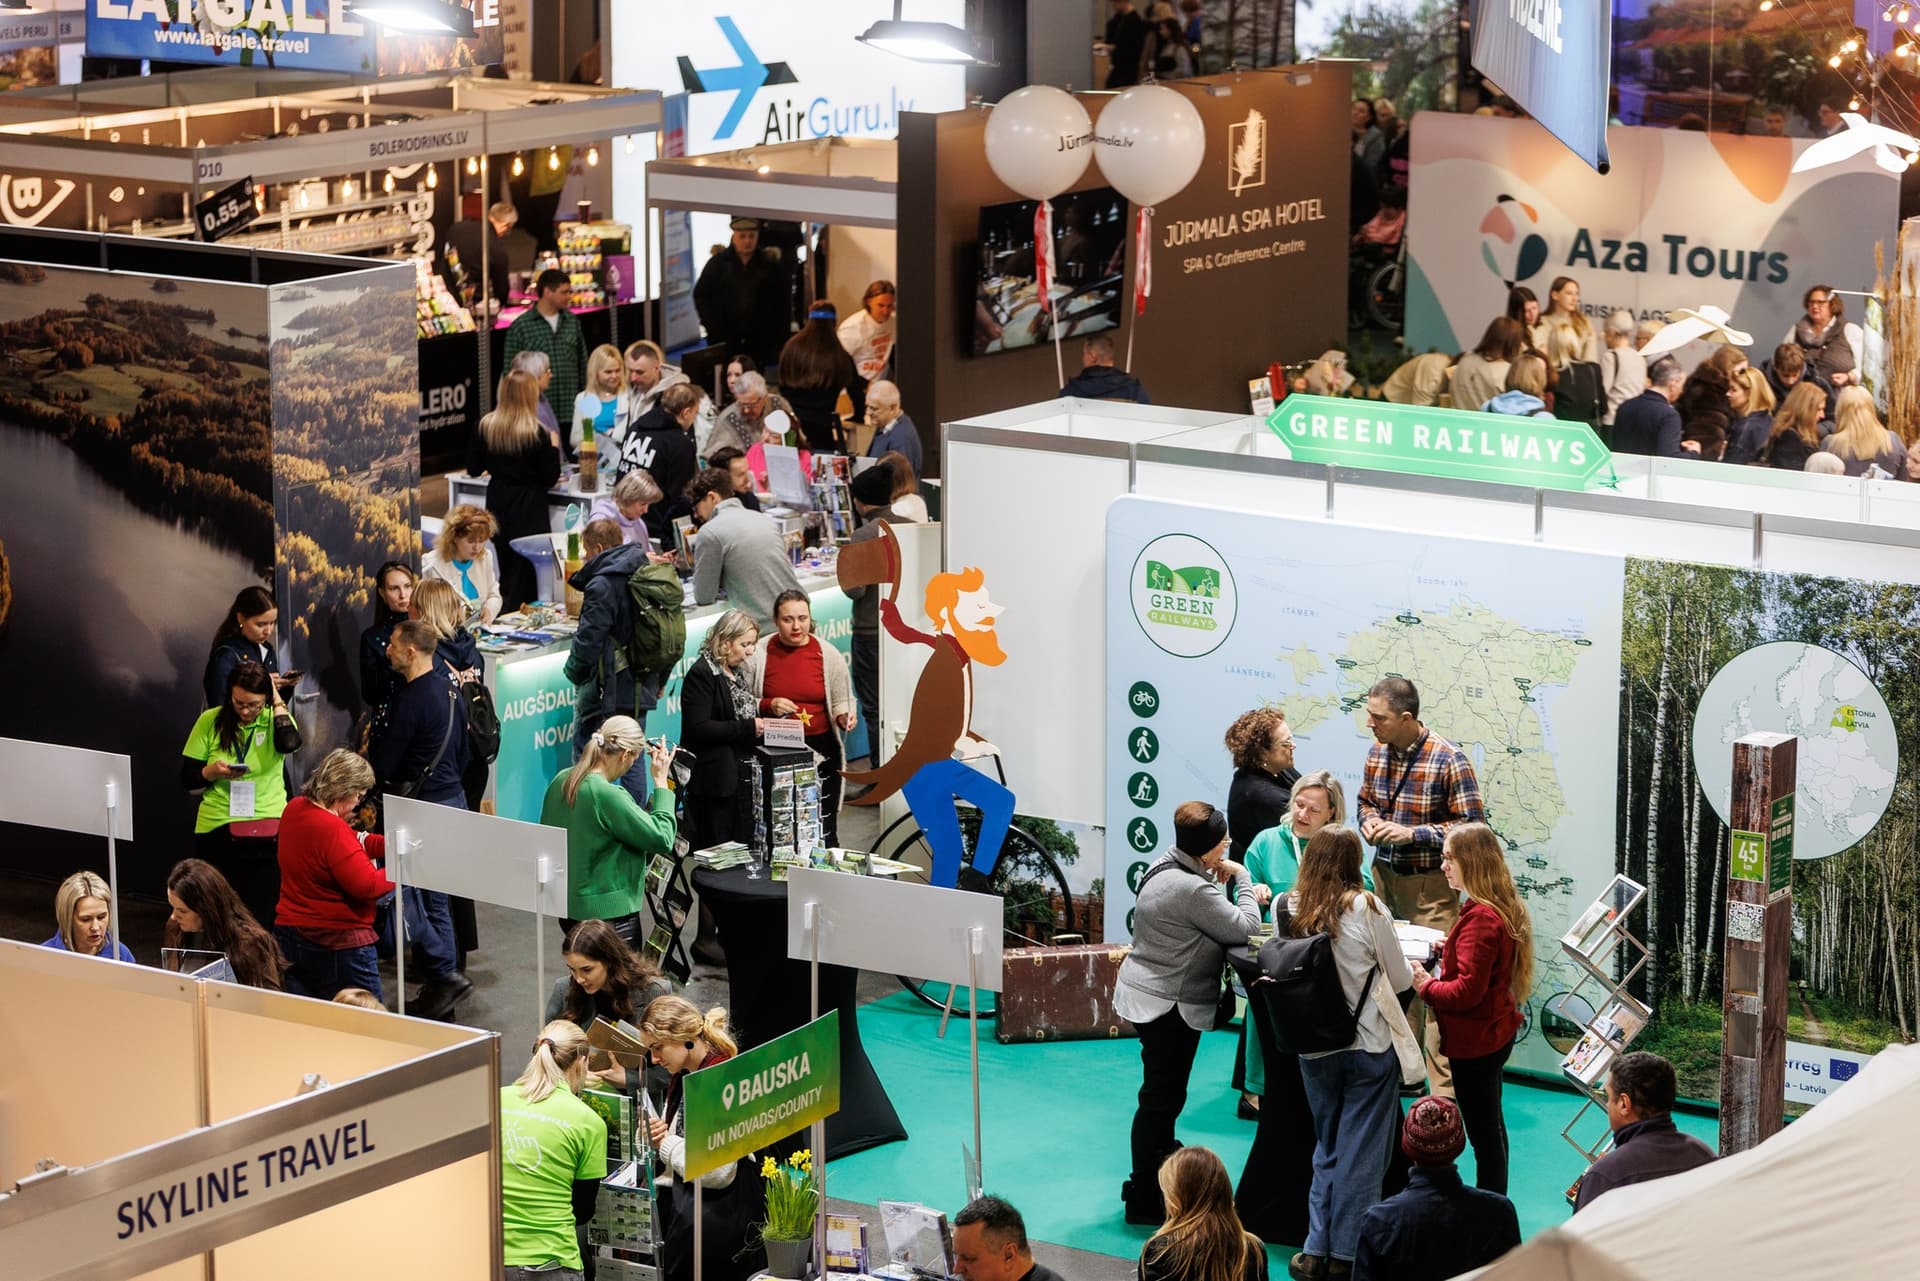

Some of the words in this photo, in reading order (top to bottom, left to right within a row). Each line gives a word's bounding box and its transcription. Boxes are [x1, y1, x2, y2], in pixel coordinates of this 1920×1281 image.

[154, 28, 309, 54] www.latgale.travel
[369, 131, 469, 157] BOLERODRINKS.LV
[204, 199, 240, 231] 0.55
[1164, 213, 1240, 248] JŪRMALA
[1241, 207, 1273, 233] SPA
[1275, 198, 1327, 226] HOTEL
[1183, 257, 1204, 274] SPA
[1205, 255, 1214, 269] &
[1215, 245, 1271, 268] Conference
[1272, 239, 1307, 256] Centre
[1566, 228, 1648, 272] Aza
[1663, 234, 1789, 284] Tours
[1290, 413, 1393, 445] GREEN
[1413, 424, 1586, 466] RAILWAYS
[1151, 594, 1214, 615] GREEN
[1151, 611, 1215, 629] RAILWAYS
[1466, 686, 1484, 698] EE
[1847, 709, 1876, 718] ESTONIA
[1847, 720, 1870, 729] LATVIA
[1738, 841, 1759, 864] 45
[739, 1051, 811, 1106] BAUSKA
[1800, 1083, 1827, 1095] Latvia
[708, 1130, 726, 1151] UN
[728, 1085, 823, 1142] NOVADS/COUNTY
[117, 1160, 248, 1240] SKYLINE
[258, 1118, 375, 1190] TRAVEL
